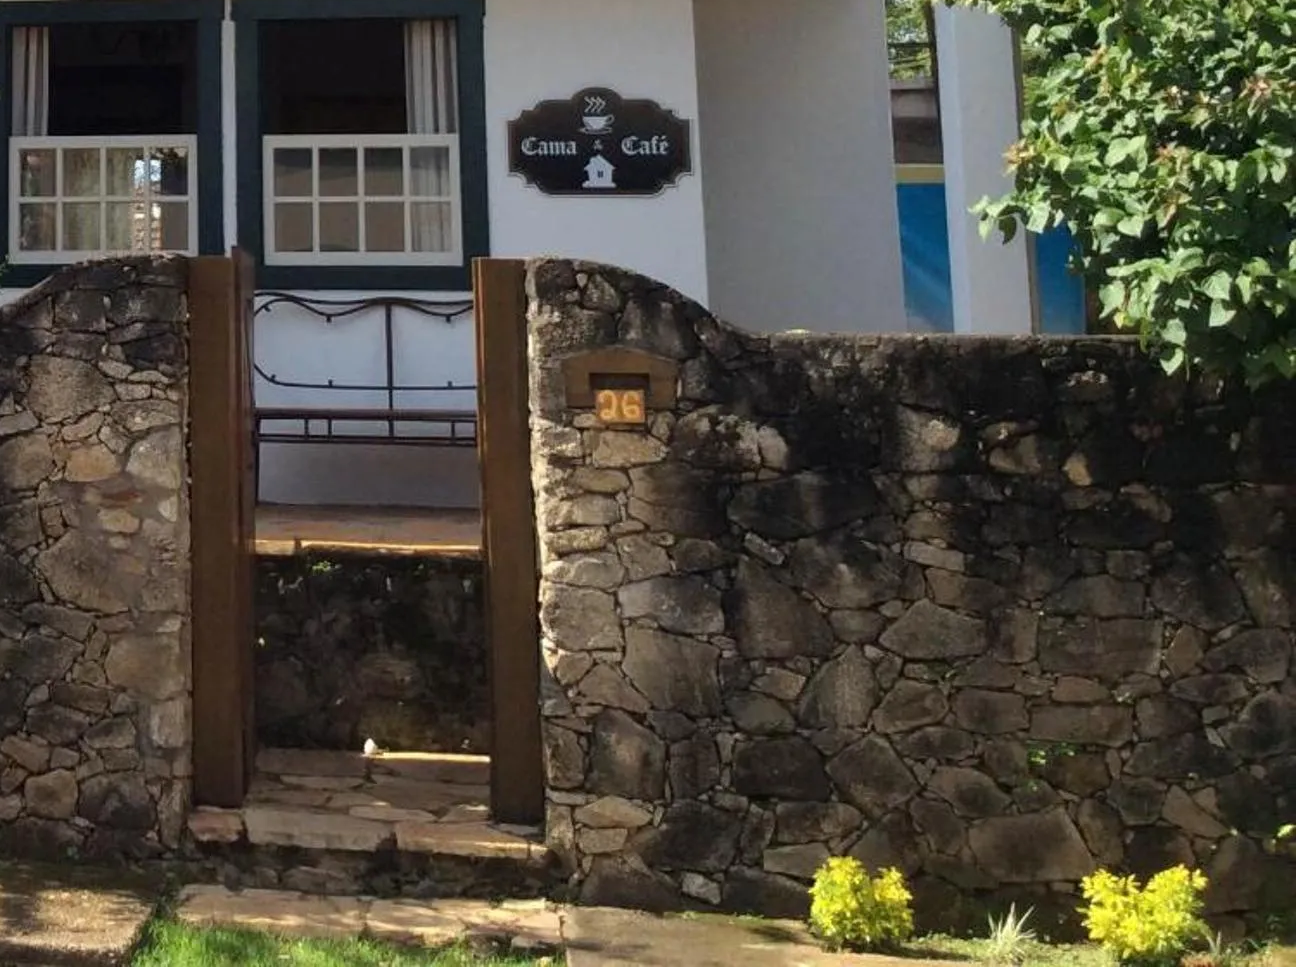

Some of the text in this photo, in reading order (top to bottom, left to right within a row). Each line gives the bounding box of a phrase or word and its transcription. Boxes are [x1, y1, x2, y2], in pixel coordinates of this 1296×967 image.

[520, 135, 670, 156] Cama & Café
